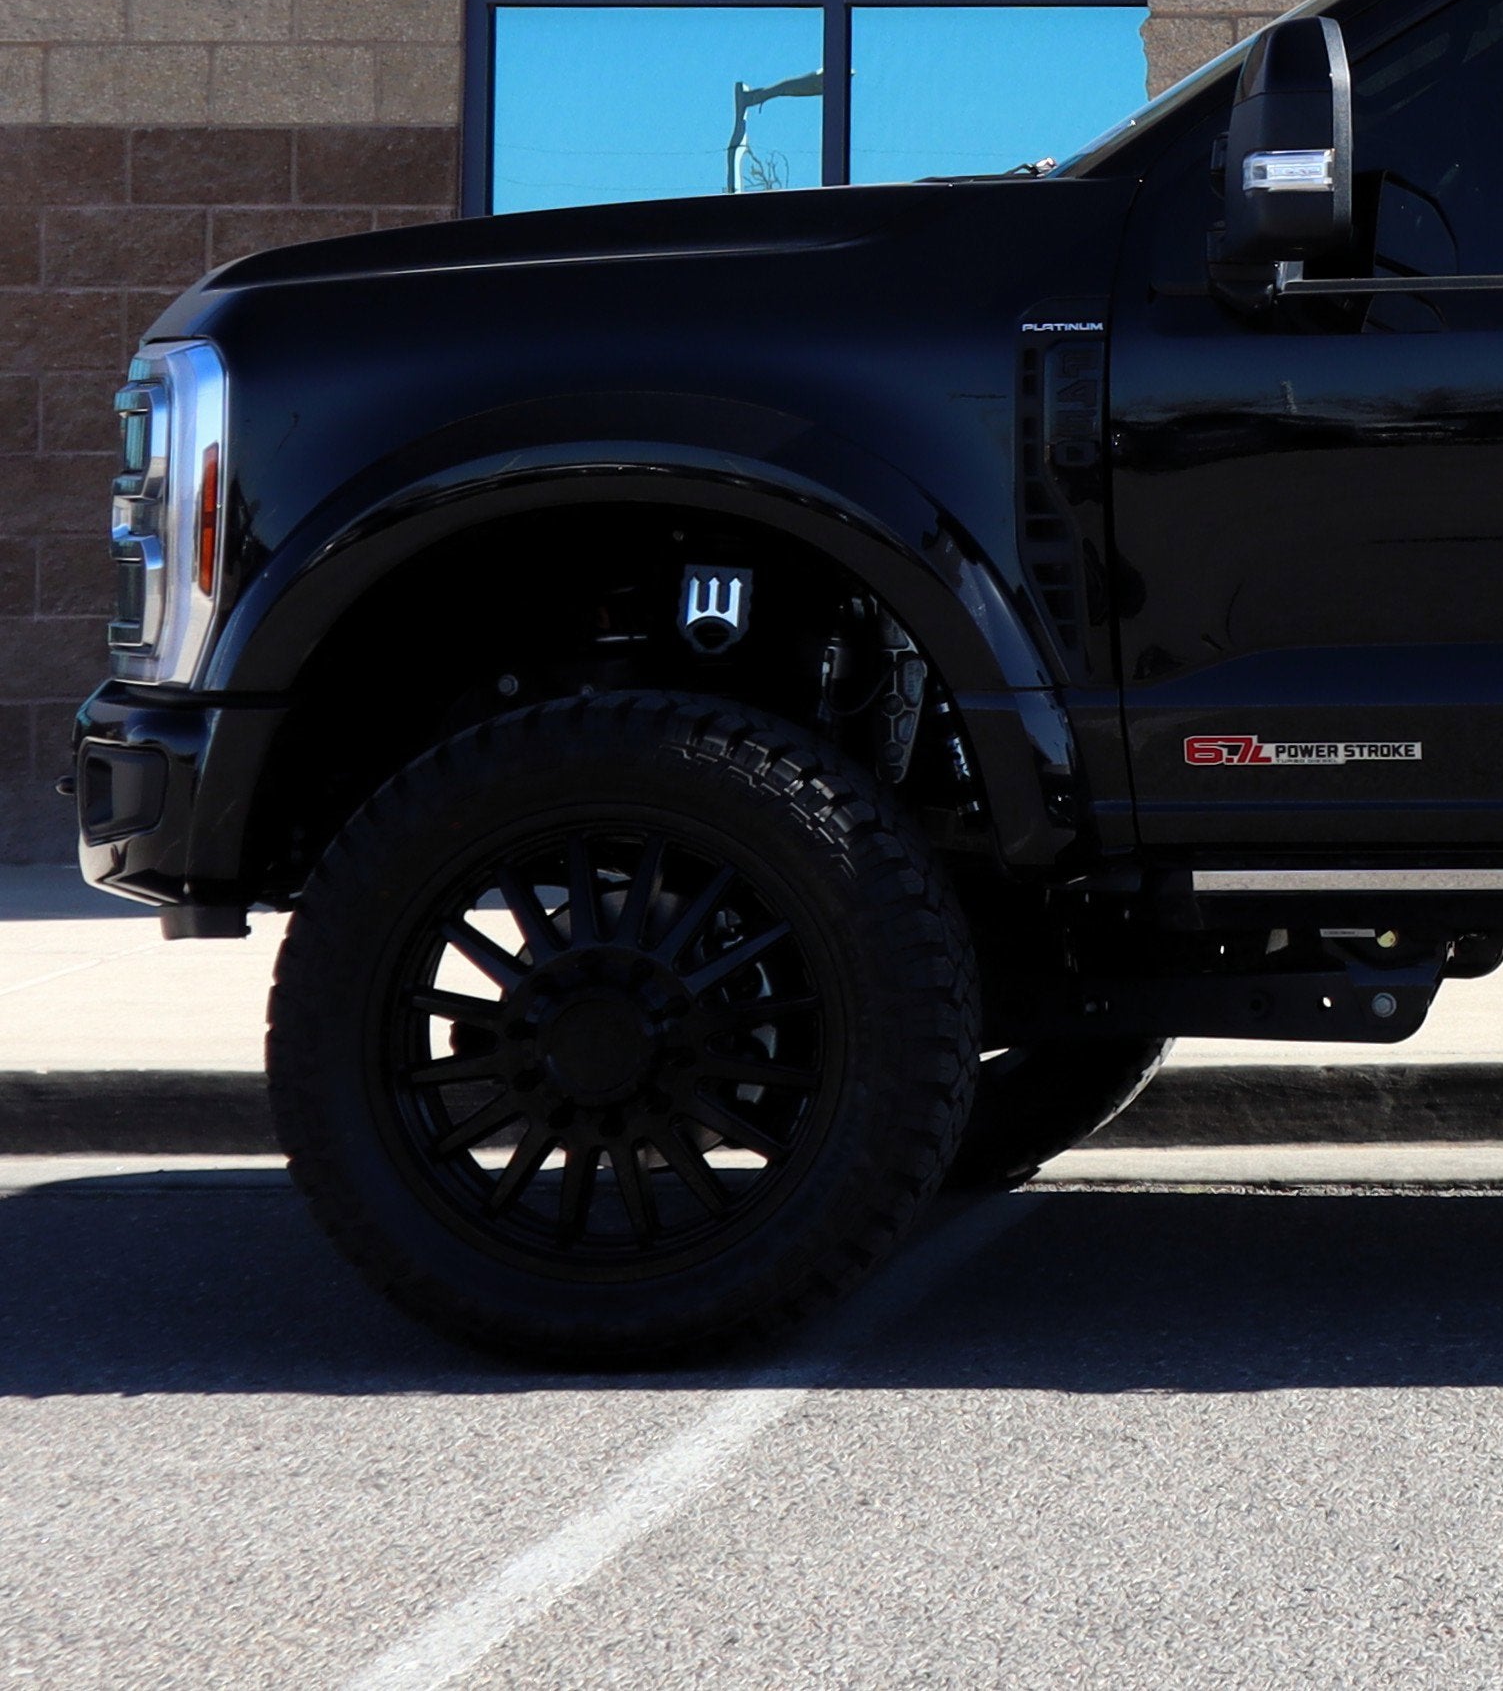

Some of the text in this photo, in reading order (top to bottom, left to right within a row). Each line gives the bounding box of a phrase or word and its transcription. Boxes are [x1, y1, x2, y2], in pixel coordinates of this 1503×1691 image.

[1021, 322, 1105, 332] PLATINUM
[1184, 736, 1416, 765] 6.7L POWER STROKE
